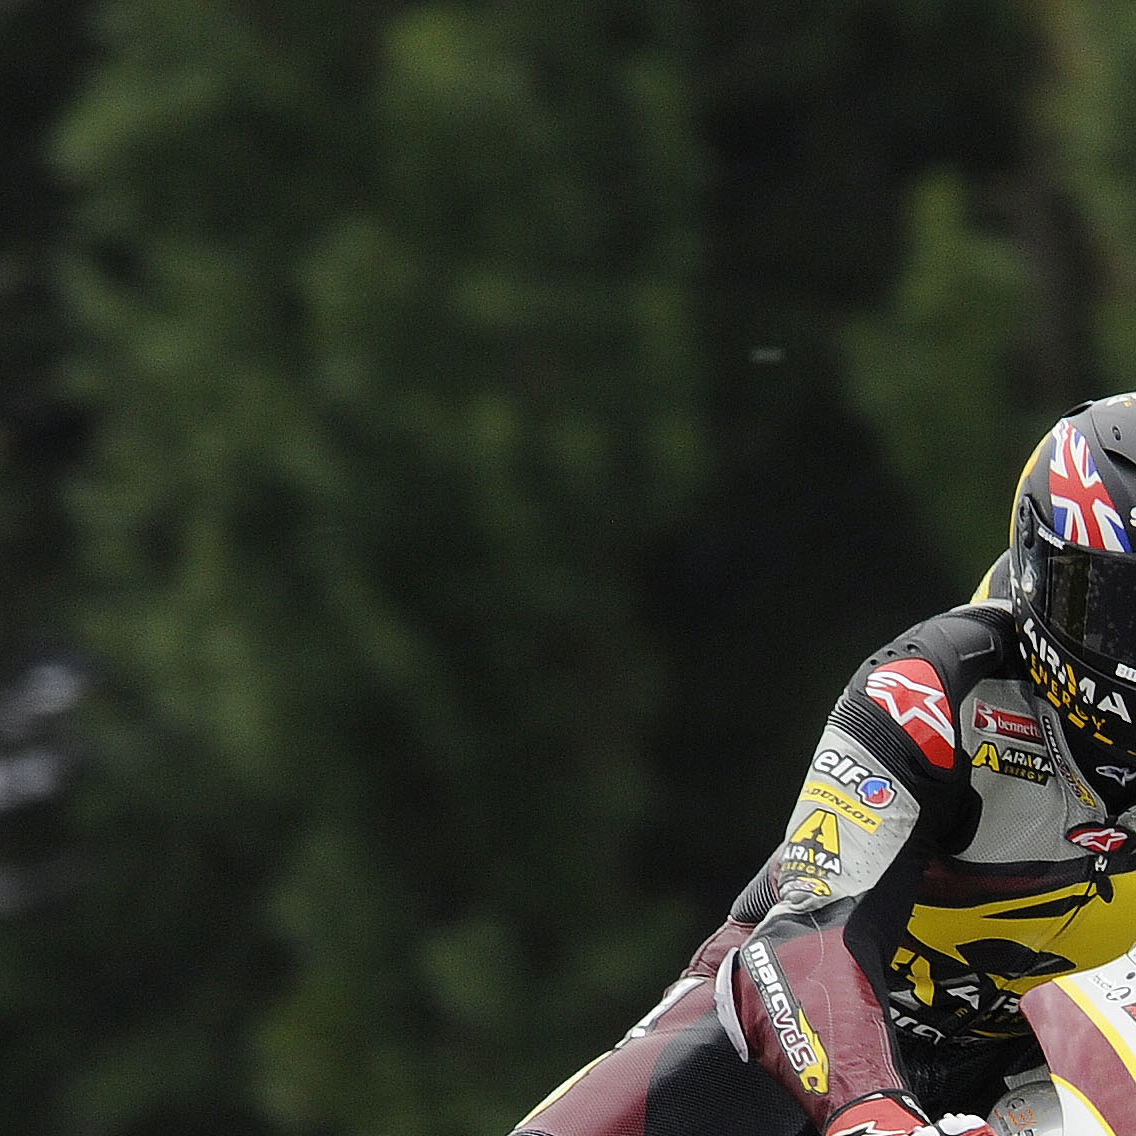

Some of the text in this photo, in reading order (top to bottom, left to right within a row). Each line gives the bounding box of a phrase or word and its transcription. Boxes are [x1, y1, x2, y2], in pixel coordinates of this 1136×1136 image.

[814, 750, 870, 785] elf
[1002, 749, 1055, 776] ARMA
[810, 787, 877, 828] DUNLOP
